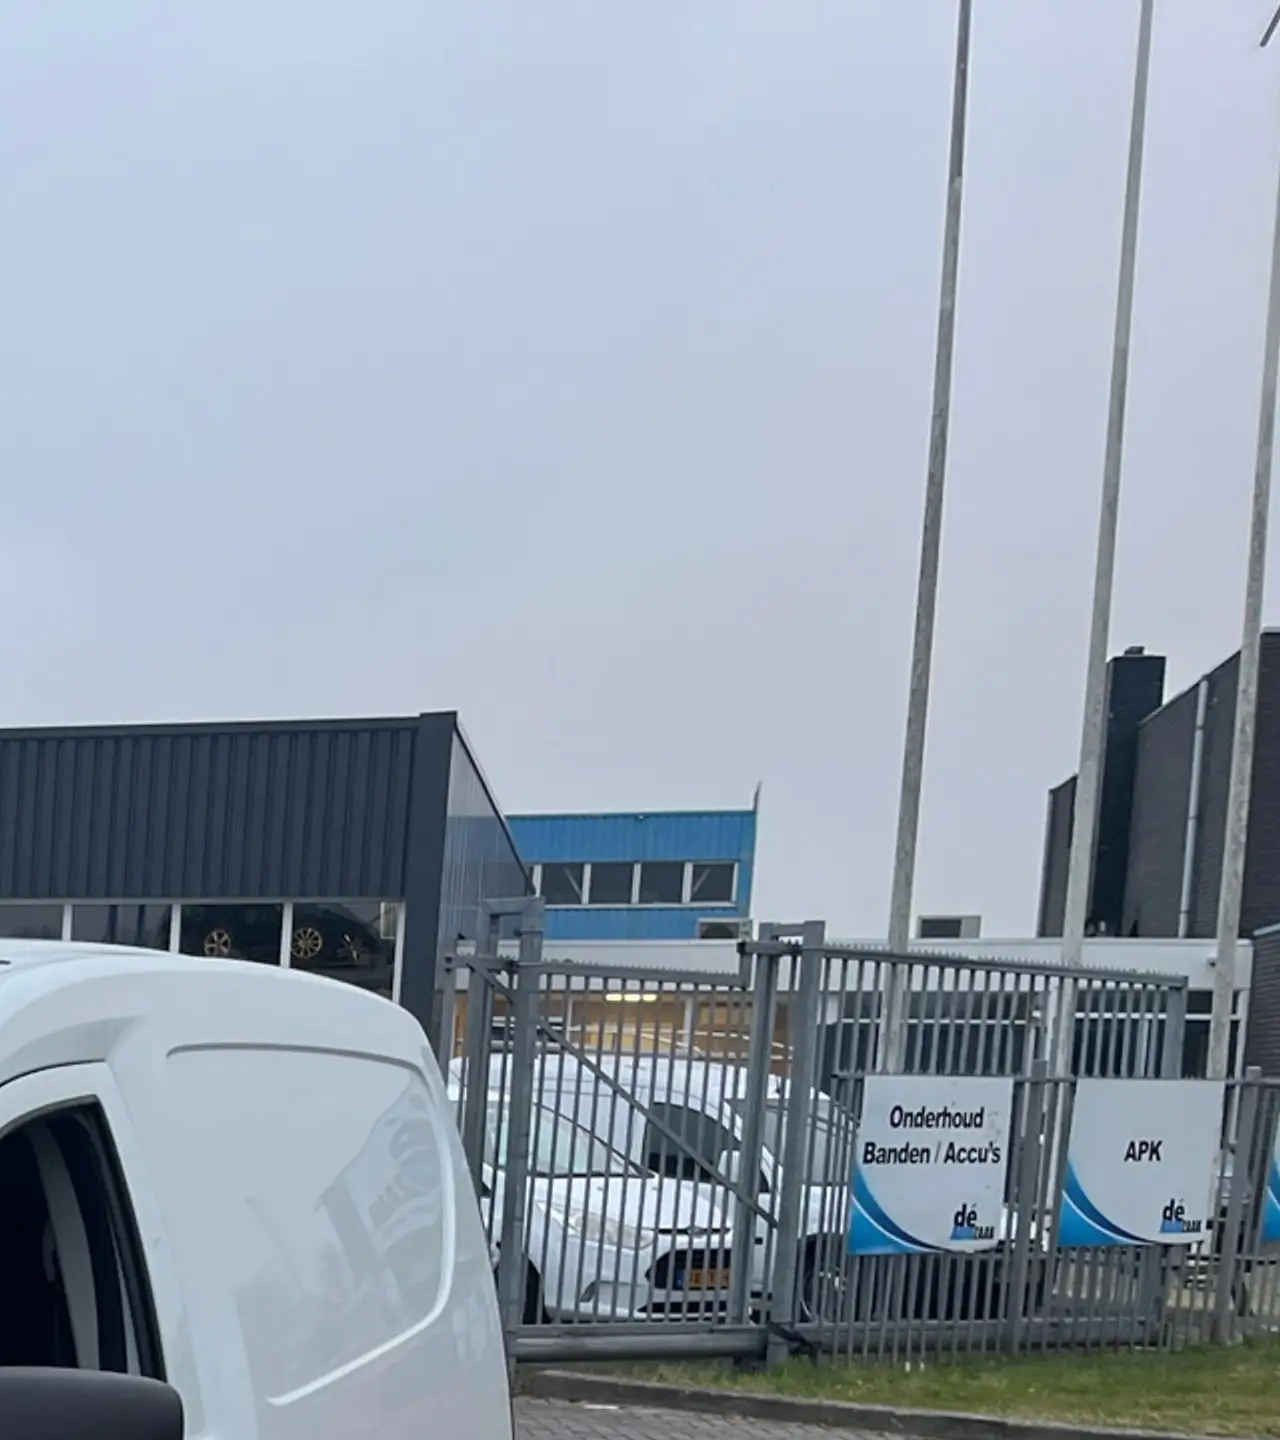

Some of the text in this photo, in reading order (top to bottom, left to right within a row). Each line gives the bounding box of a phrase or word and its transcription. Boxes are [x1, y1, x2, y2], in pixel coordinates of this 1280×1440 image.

[890, 1105, 984, 1128] Onderhoud
[863, 1142, 930, 1164] Banden
[944, 1141, 1001, 1164] Accu's
[1124, 1140, 1163, 1162] APK
